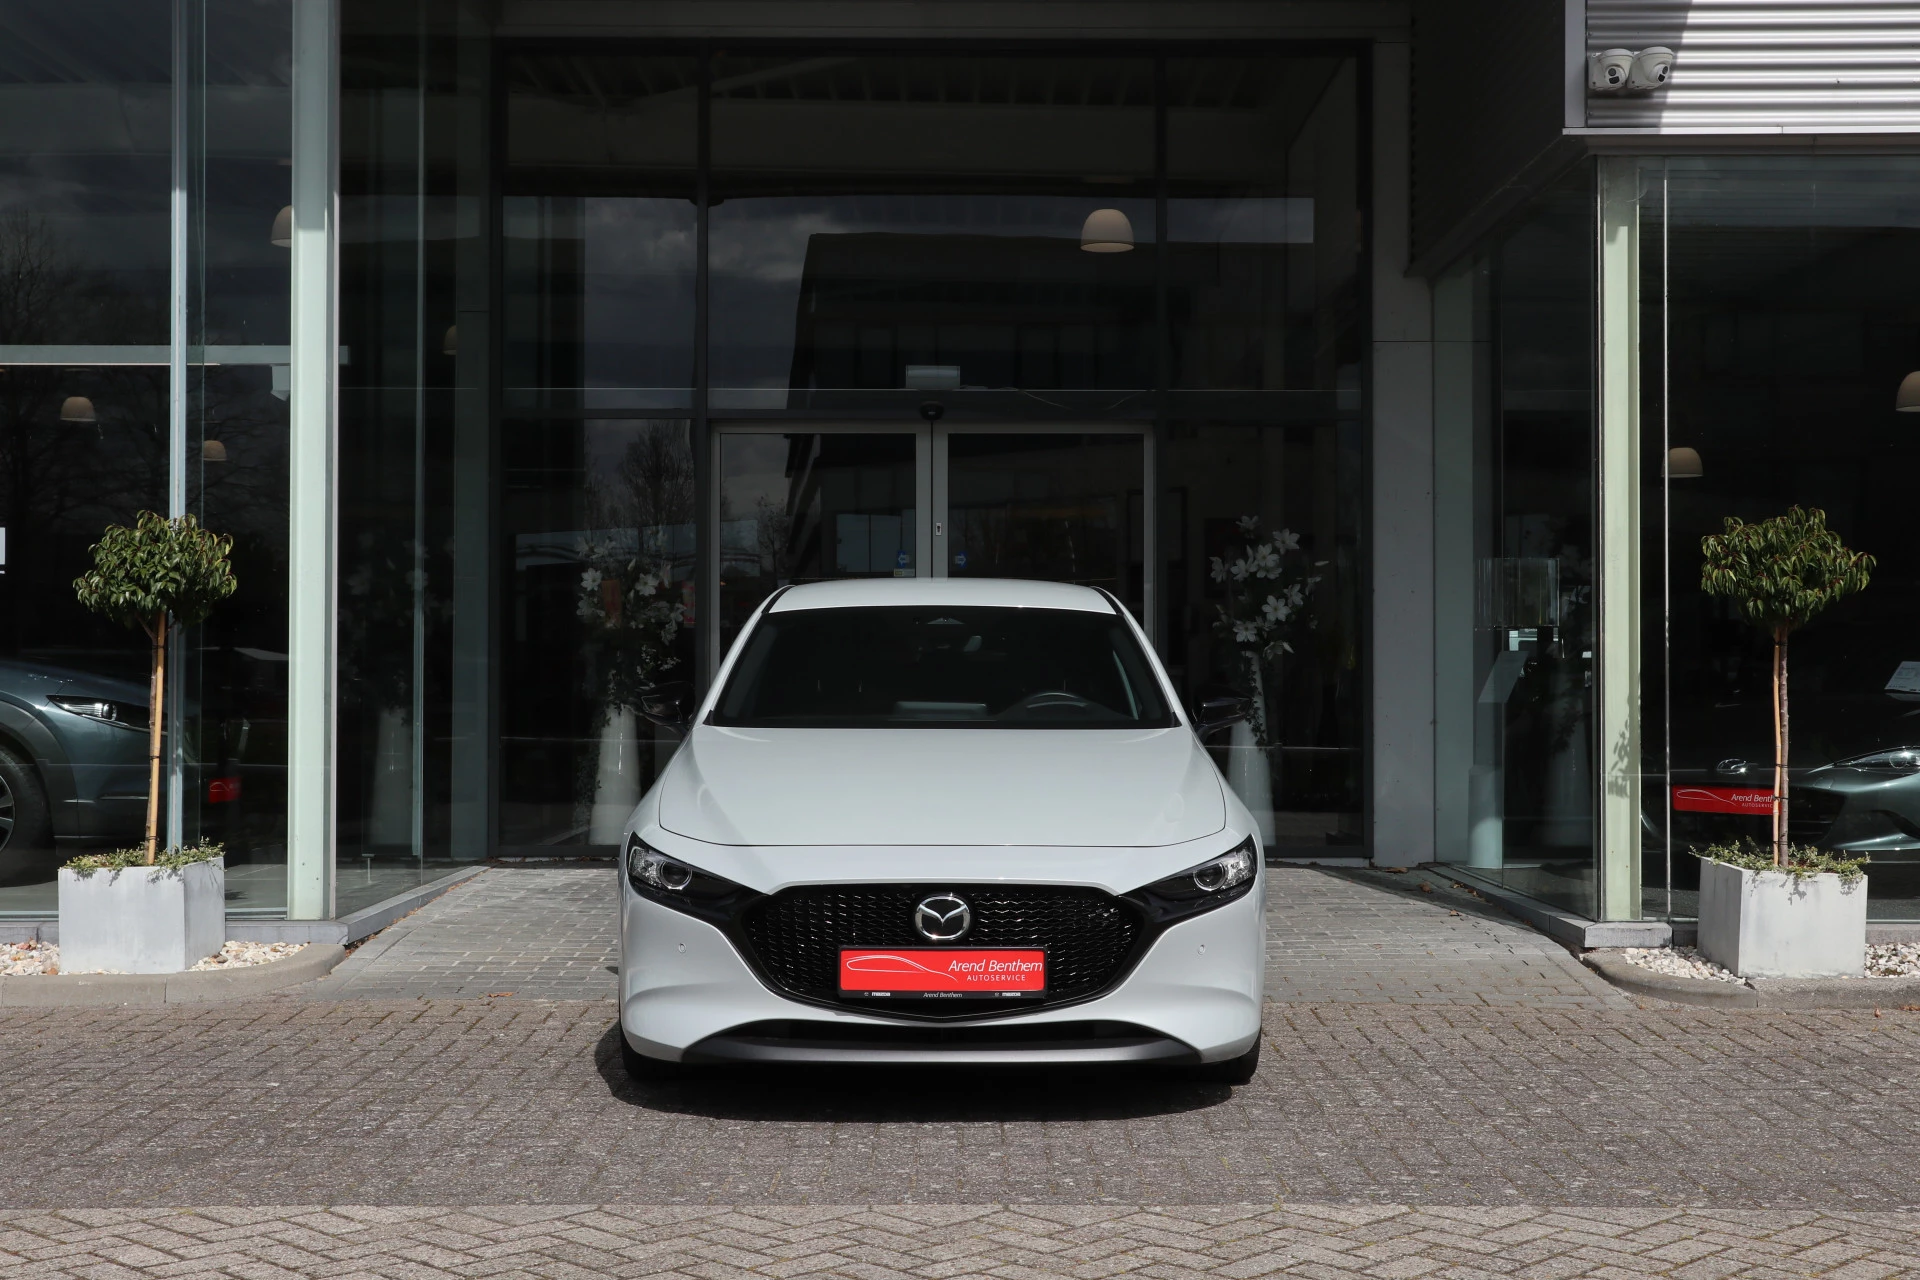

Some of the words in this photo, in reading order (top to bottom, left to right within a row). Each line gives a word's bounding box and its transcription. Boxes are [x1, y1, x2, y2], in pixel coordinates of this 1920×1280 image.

[948, 959, 986, 972] Arend
[988, 959, 1043, 972] Benthem
[966, 974, 1026, 982] AUTOSERVICE
